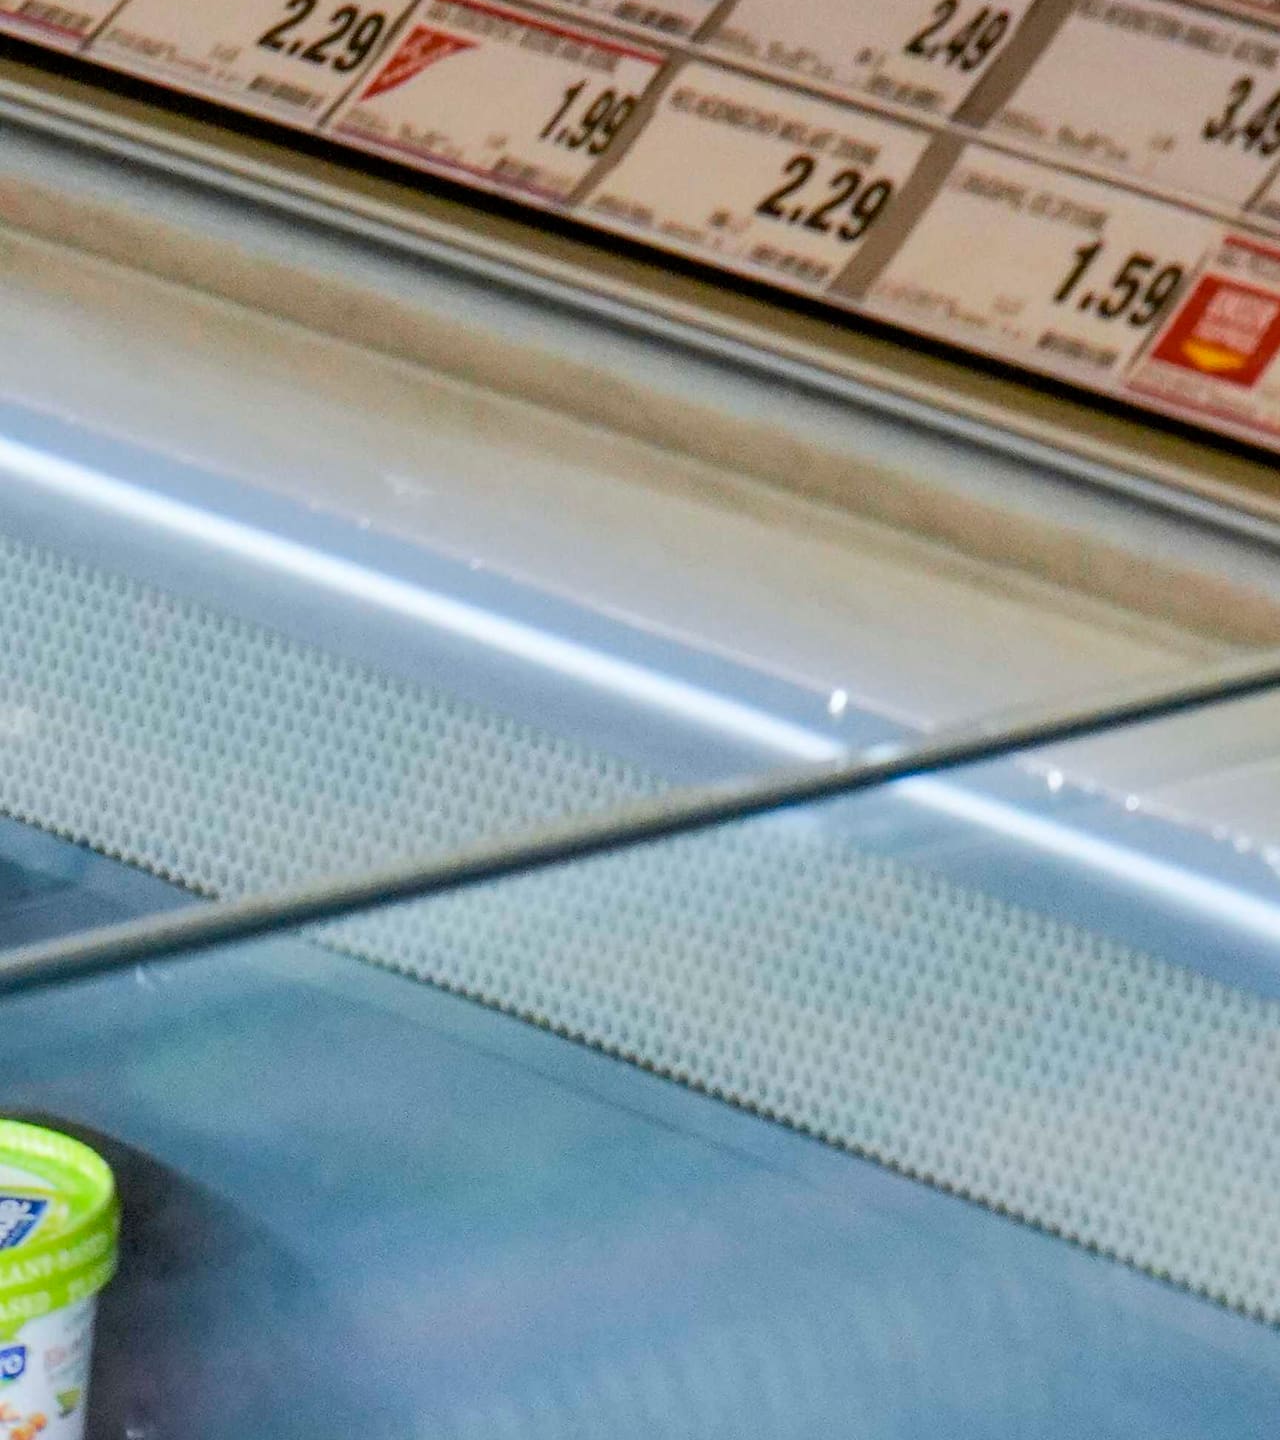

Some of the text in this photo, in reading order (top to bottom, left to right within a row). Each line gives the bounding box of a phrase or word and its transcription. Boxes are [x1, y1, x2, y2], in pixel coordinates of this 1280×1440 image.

[539, 78, 636, 156] 1.99
[755, 155, 894, 243] 2.29
[1053, 238, 1183, 327] 1.59
